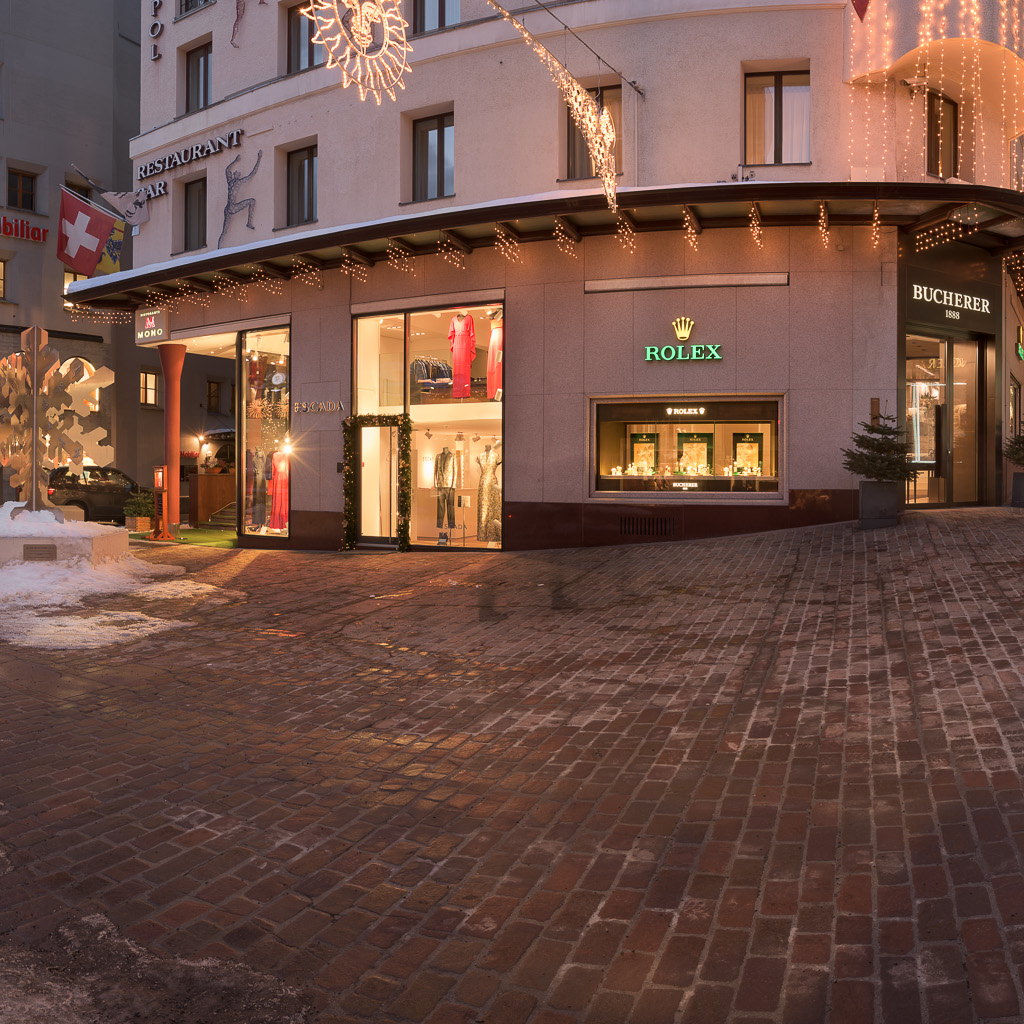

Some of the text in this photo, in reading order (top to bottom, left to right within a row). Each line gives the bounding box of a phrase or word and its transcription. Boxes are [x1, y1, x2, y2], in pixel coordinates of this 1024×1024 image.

[136, 128, 244, 181] RESTAURANT
[912, 284, 991, 314] BUCHERER
[945, 309, 960, 320] 1888
[137, 328, 163, 339] MONO
[644, 344, 723, 361] ROLEX
[294, 401, 345, 413] ESCADA
